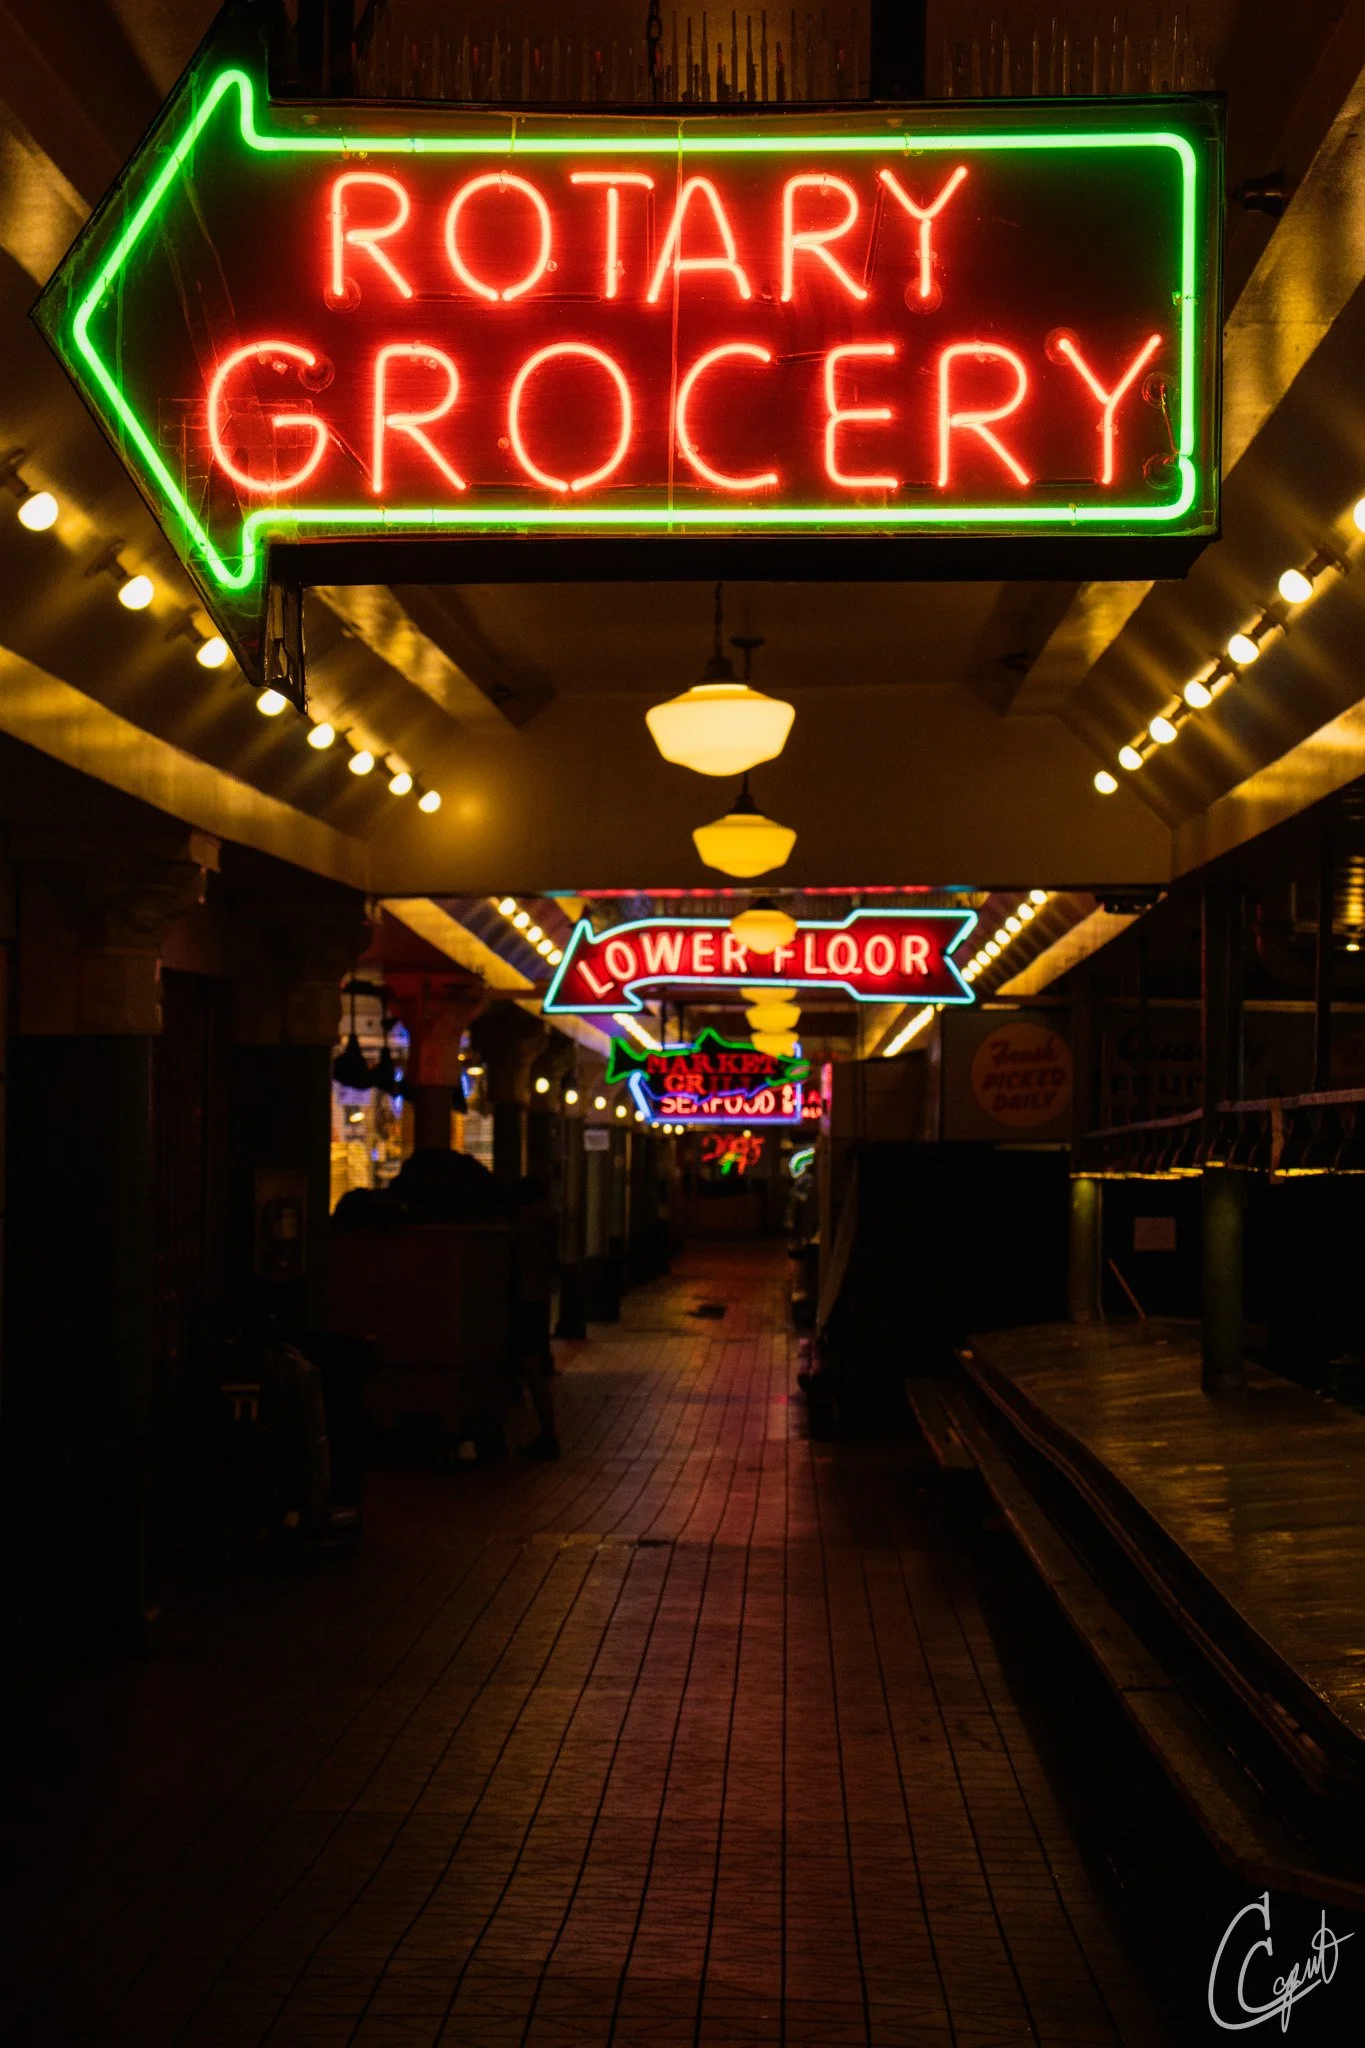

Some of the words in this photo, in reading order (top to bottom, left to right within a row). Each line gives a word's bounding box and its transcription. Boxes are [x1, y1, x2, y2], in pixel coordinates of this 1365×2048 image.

[324, 164, 970, 303] ROTARY
[204, 333, 1164, 494] GROCERY
[577, 933, 749, 999] LOWER
[773, 934, 930, 977] FLOOR
[646, 1052, 779, 1075] MARKET
[660, 1089, 776, 1115] SEAFOOD
